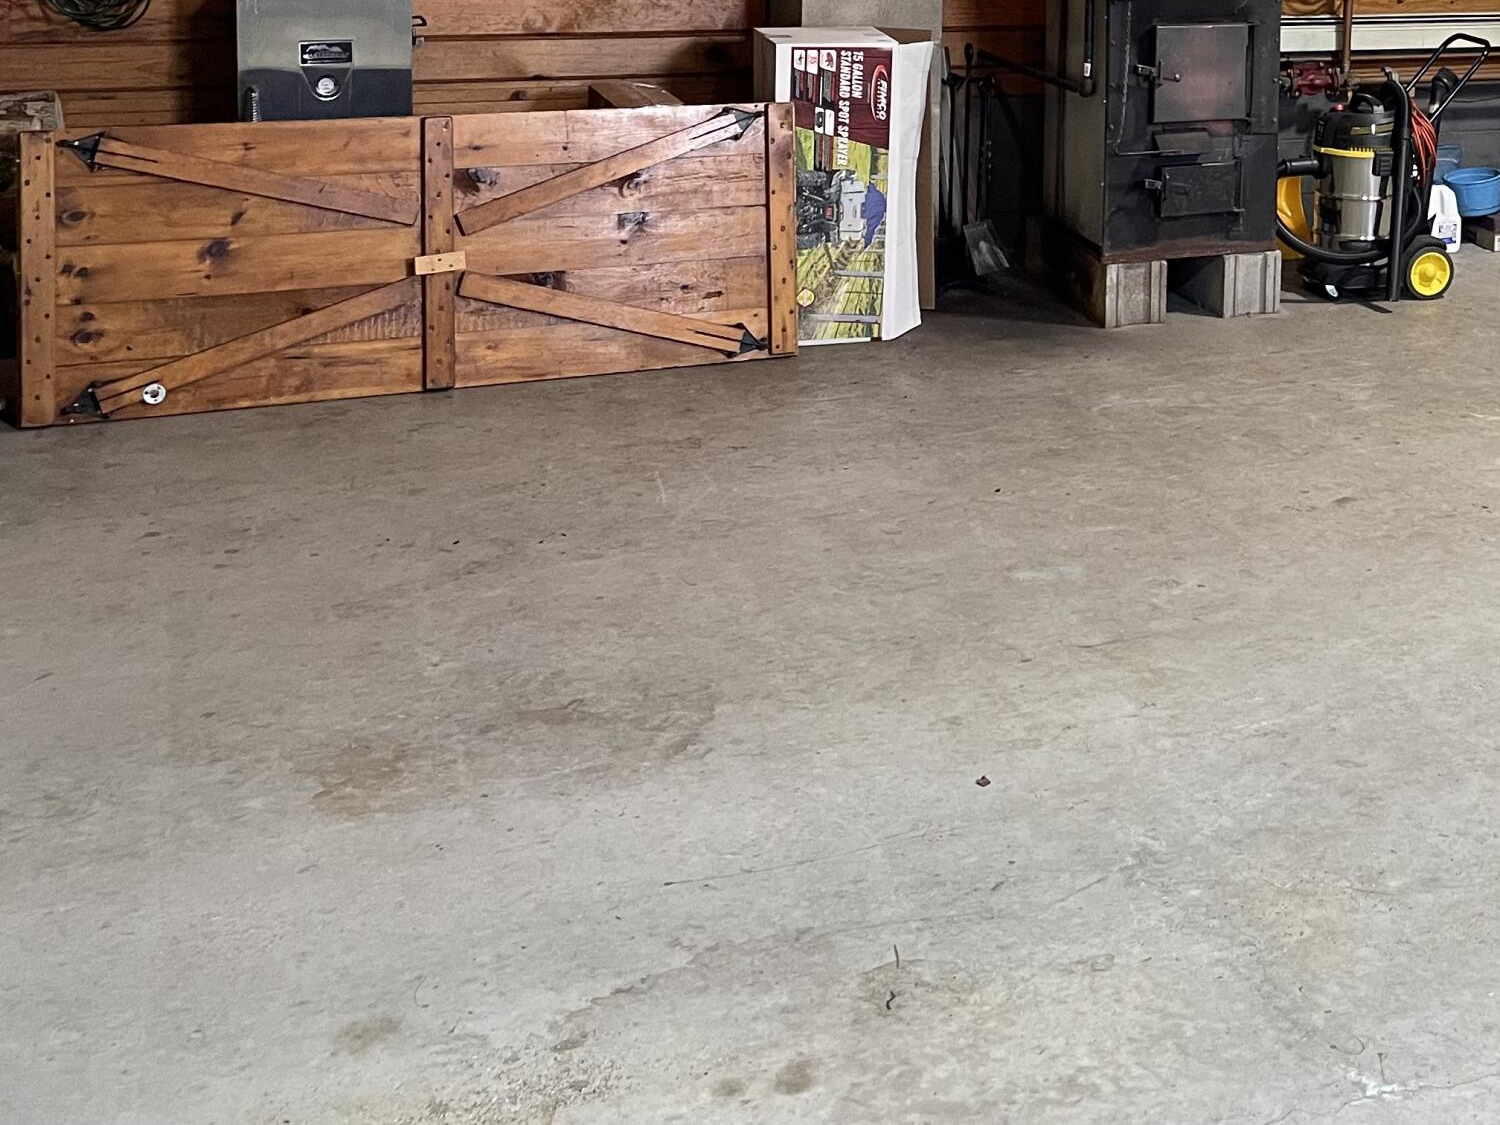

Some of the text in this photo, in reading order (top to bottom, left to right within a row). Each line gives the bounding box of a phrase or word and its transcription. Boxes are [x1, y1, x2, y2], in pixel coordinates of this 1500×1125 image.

[851, 50, 864, 99] 15 GALLON
[836, 49, 852, 166] STANDARD SPOT SPRAYER
[877, 78, 888, 121] FIMCO
